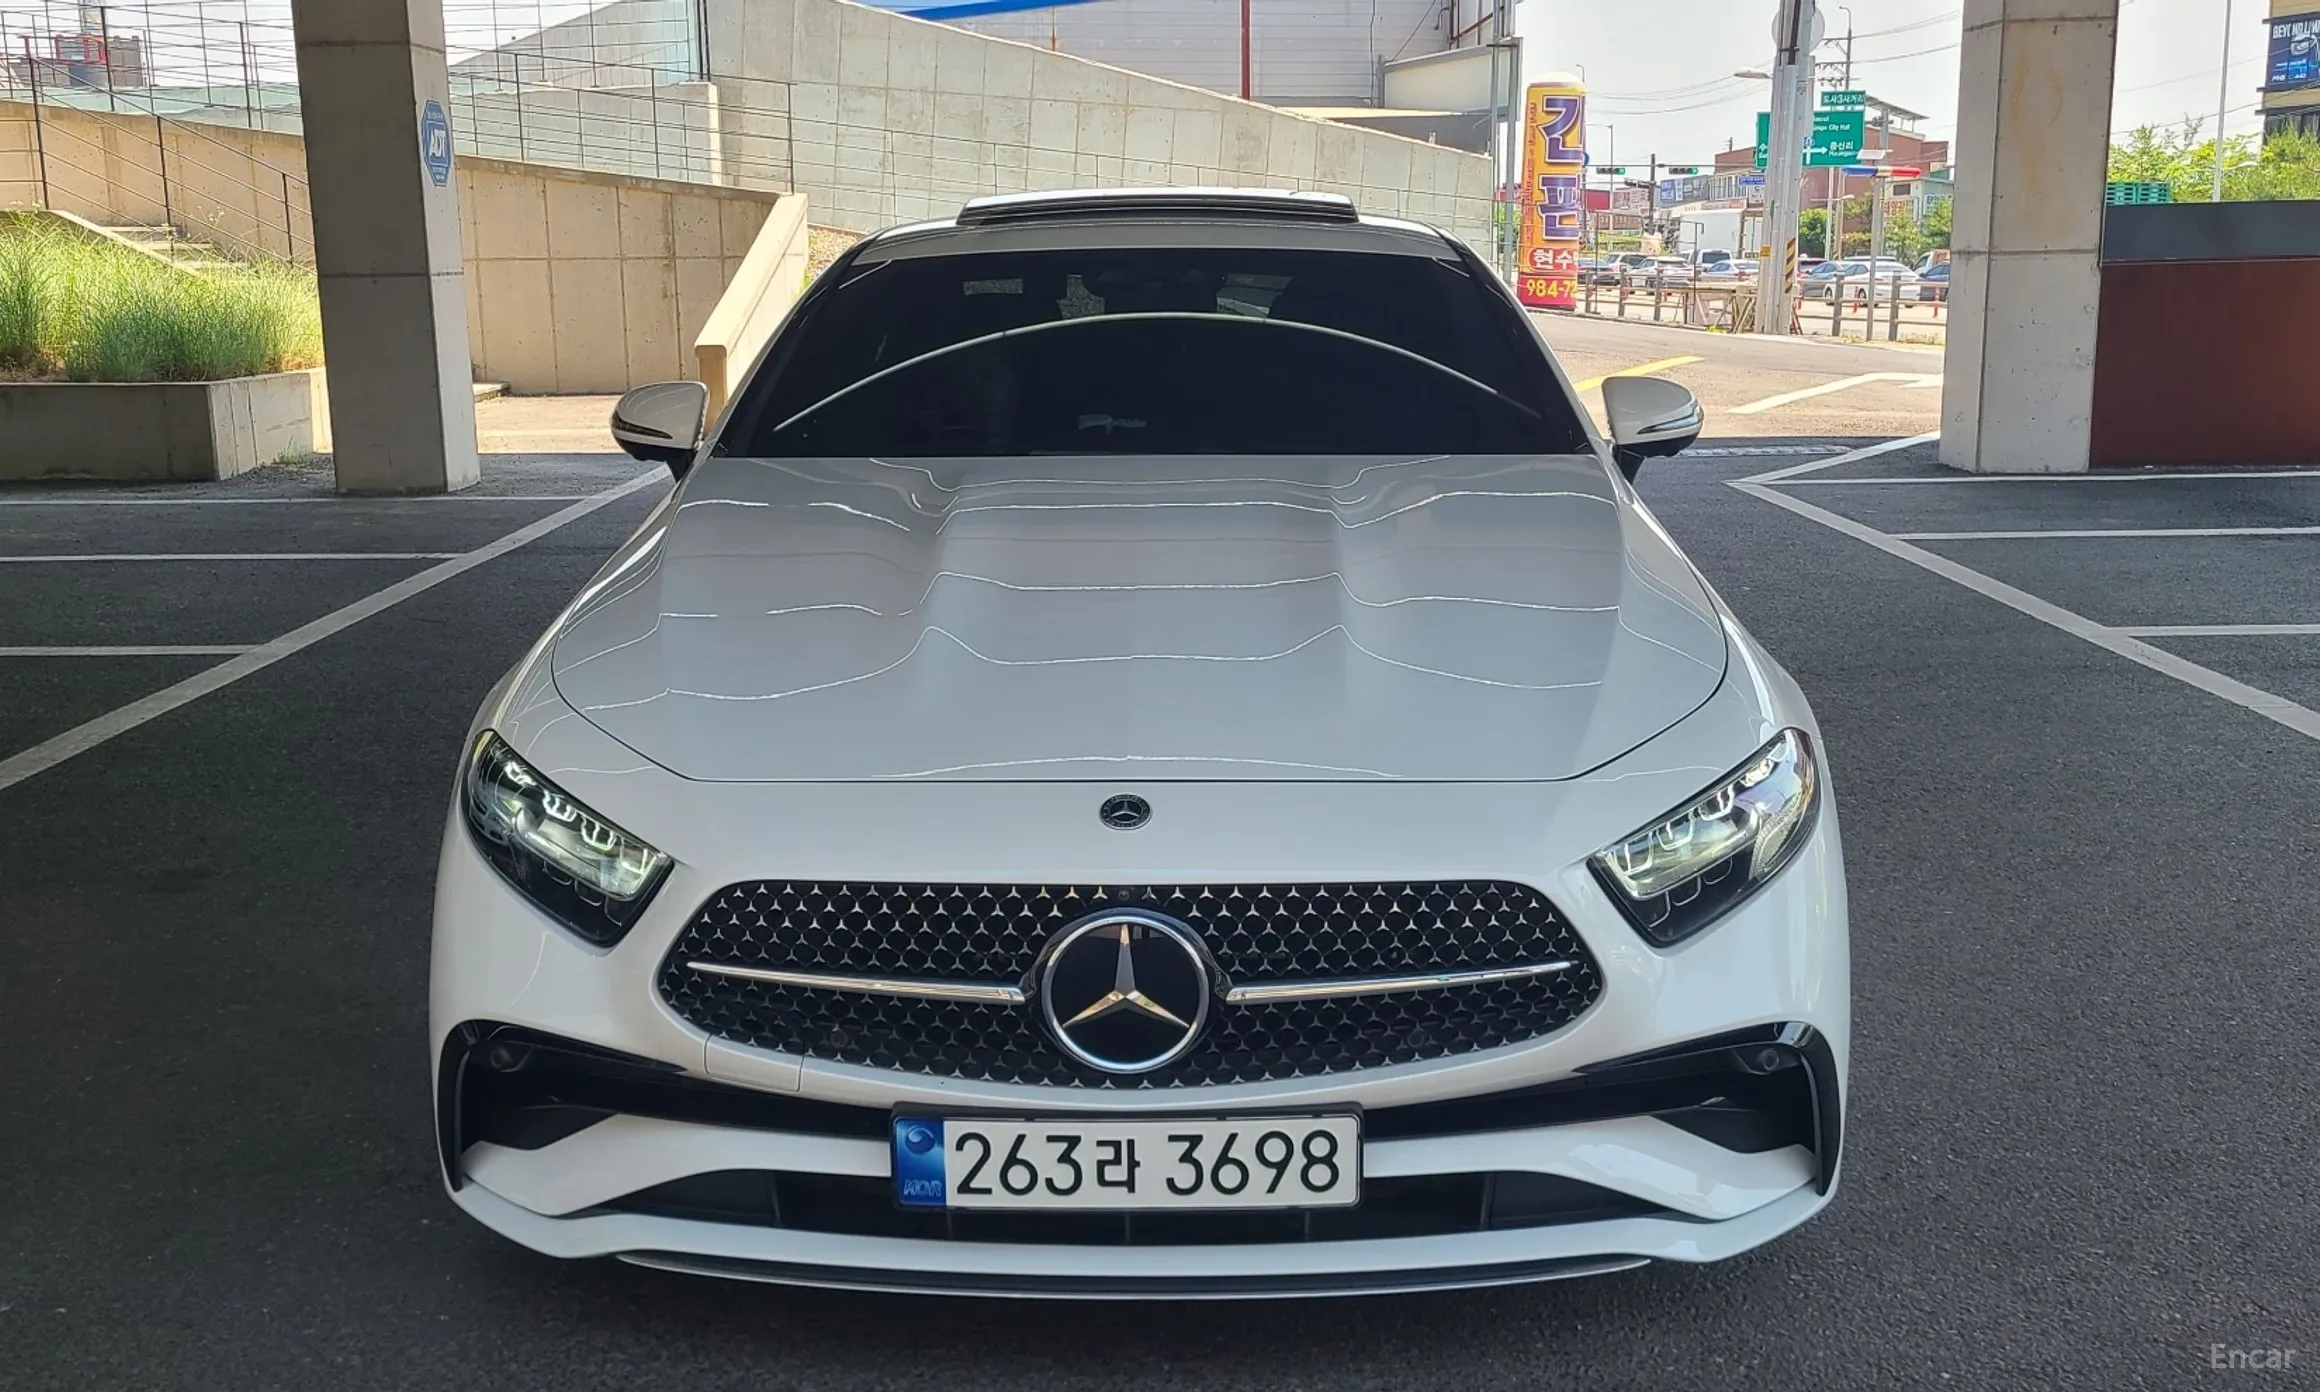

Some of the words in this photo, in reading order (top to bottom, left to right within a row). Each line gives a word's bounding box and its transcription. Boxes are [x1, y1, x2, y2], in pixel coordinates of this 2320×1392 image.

[1533, 249, 1578, 270] 현수
[955, 1132, 1141, 1196] 263라
[1166, 1128, 1340, 1196] 3698
